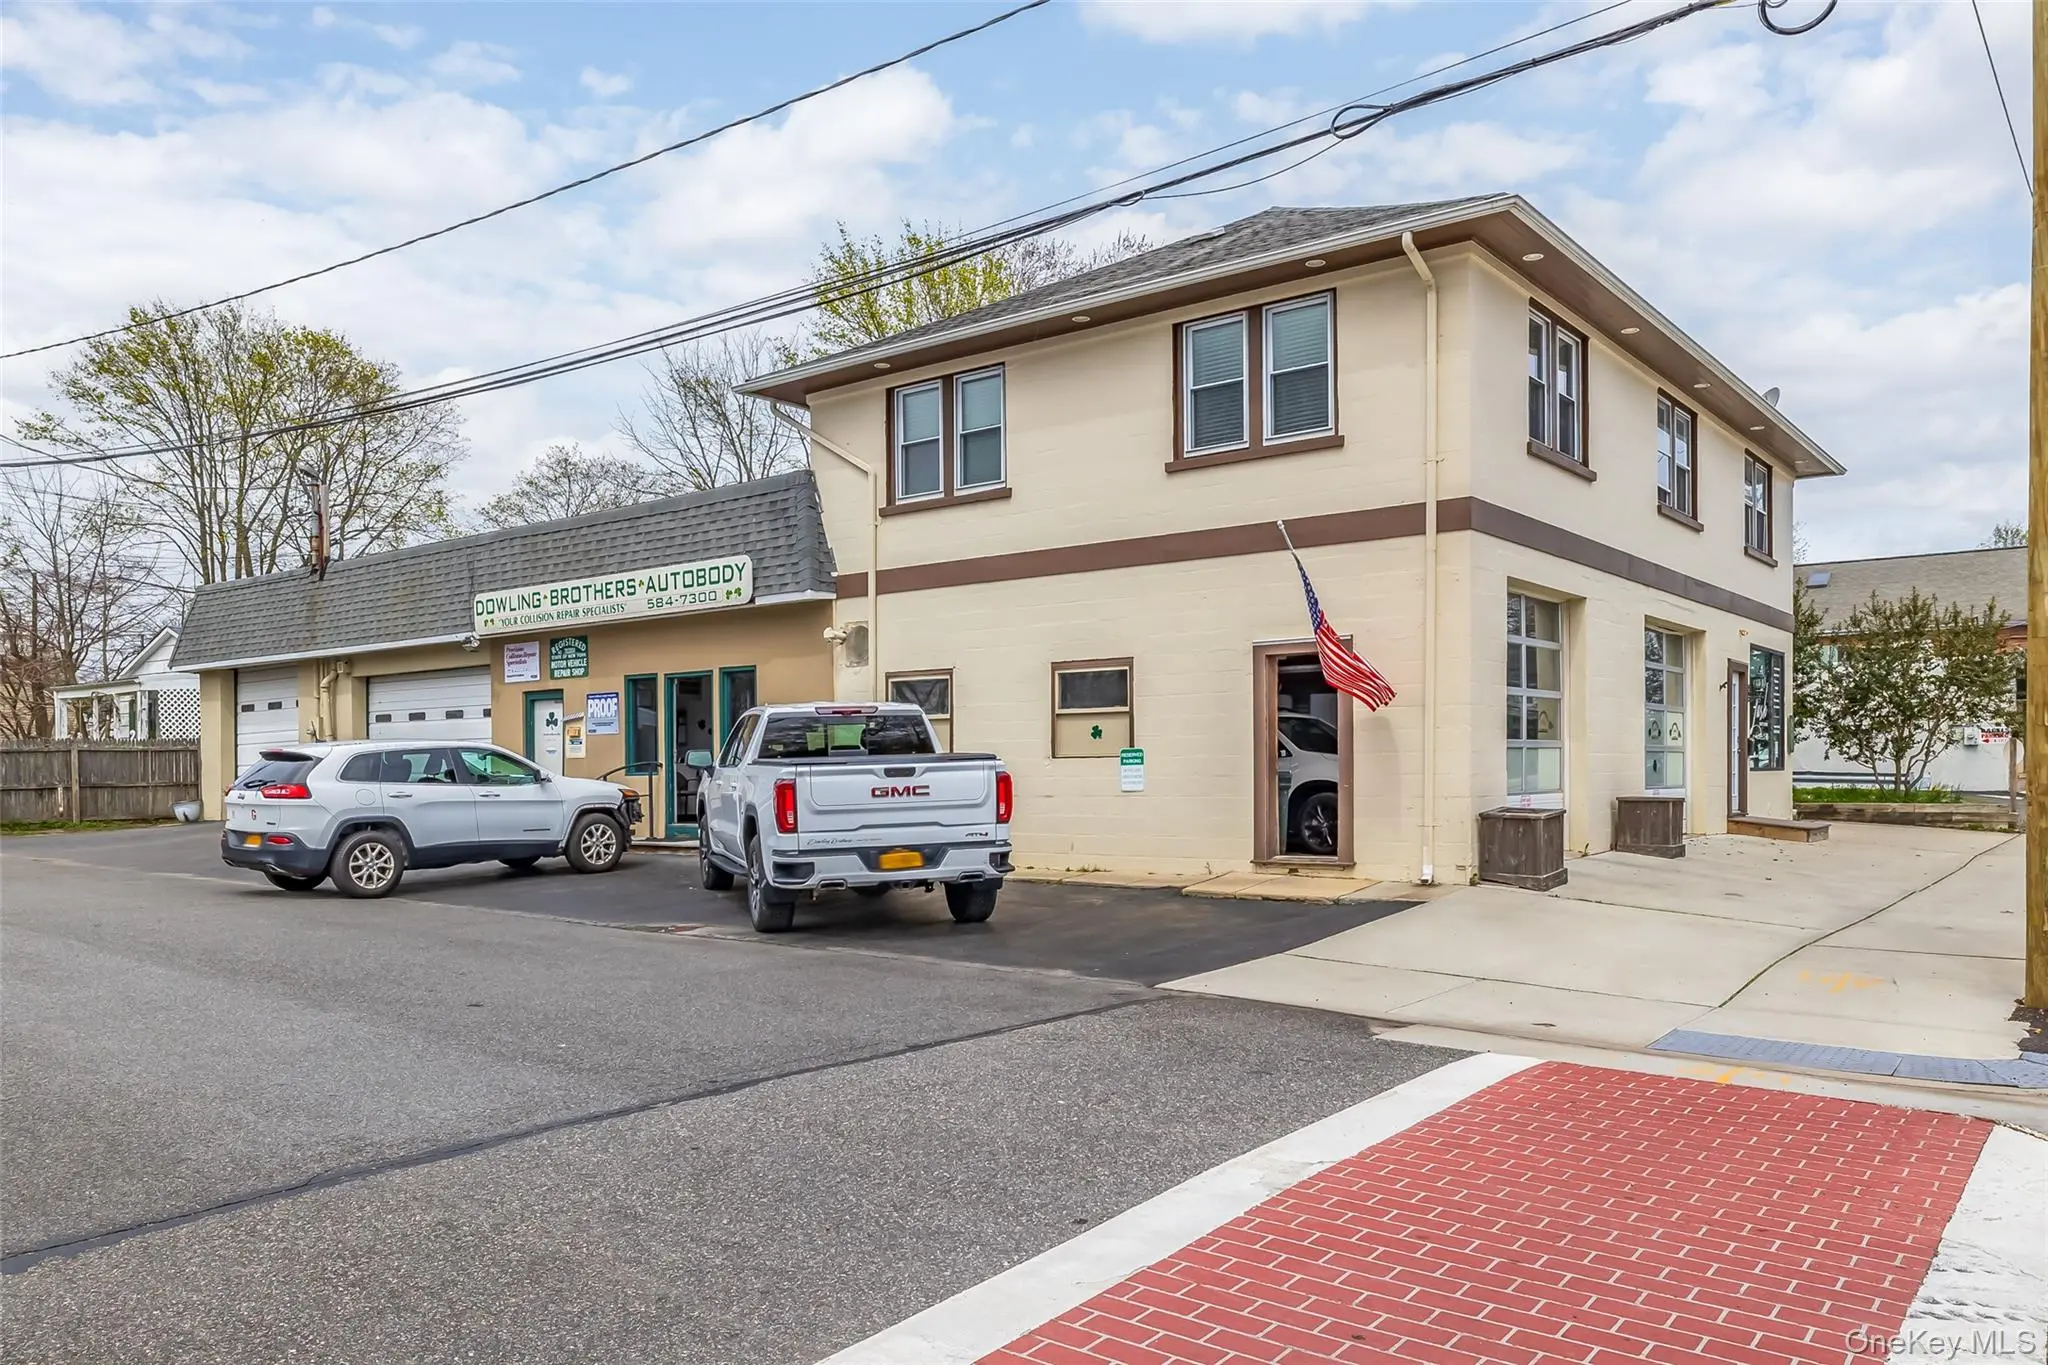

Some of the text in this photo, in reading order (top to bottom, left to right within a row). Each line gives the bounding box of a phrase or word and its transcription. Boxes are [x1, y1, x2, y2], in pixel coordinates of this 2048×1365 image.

[476, 561, 747, 617] DOWLING BROTHERS AUTOBODY
[647, 590, 718, 610] 584-7300
[520, 611, 555, 625] COLLISION
[556, 607, 580, 620] REPAIR
[551, 638, 586, 654] REGISTERED
[551, 658, 587, 669] MOTOR VEHICLE
[554, 667, 585, 678] REPAIR SHOP
[588, 698, 618, 718] PROOF
[871, 785, 930, 798] GMC
